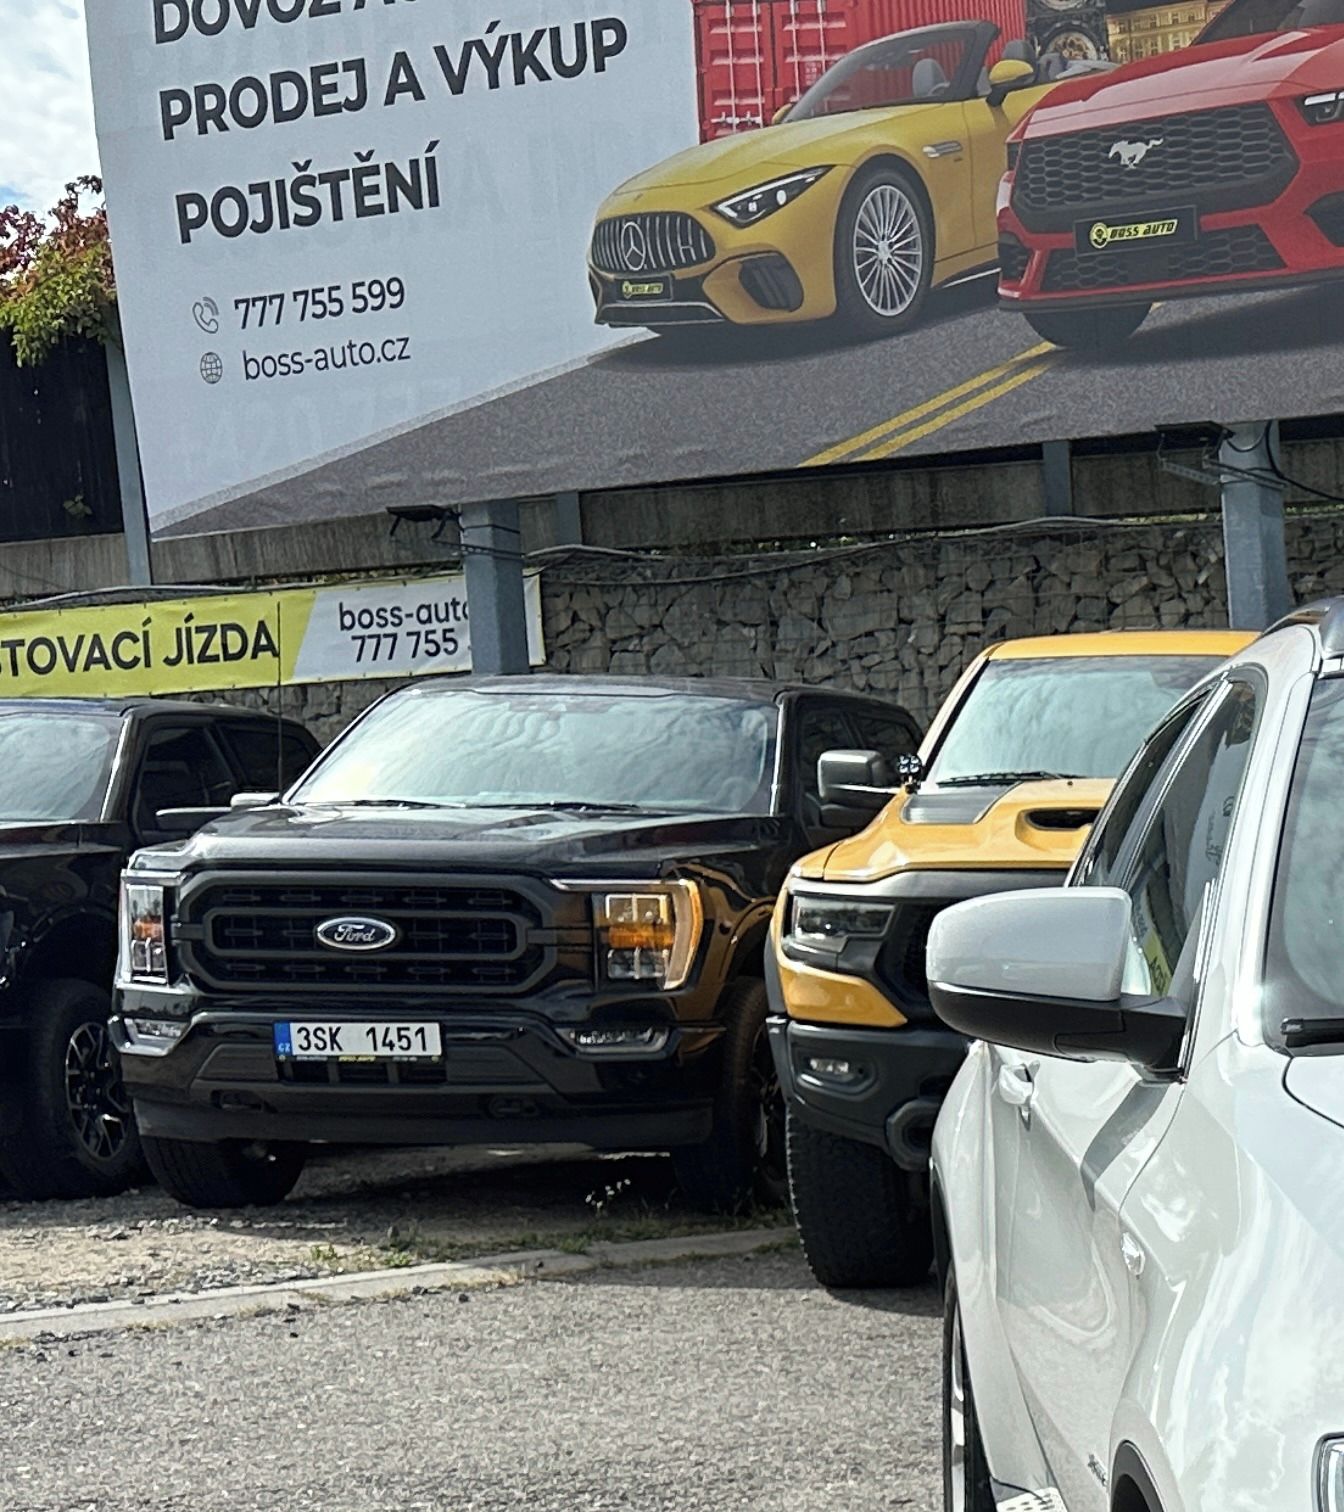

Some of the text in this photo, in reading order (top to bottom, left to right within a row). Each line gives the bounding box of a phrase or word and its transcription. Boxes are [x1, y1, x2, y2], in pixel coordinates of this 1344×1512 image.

[159, 17, 628, 140] PRODEJ A VÝKUP
[175, 139, 441, 244] POJIŠTĚNÍ
[234, 277, 405, 330] 777 755 599
[242, 337, 411, 380] boss-auto.cz
[0, 612, 279, 677] TOVACÍ JÍZDA
[351, 628, 459, 663] 777 755
[334, 923, 376, 942] Ford
[296, 1026, 344, 1052] 3SK
[366, 1026, 428, 1052] 1451
